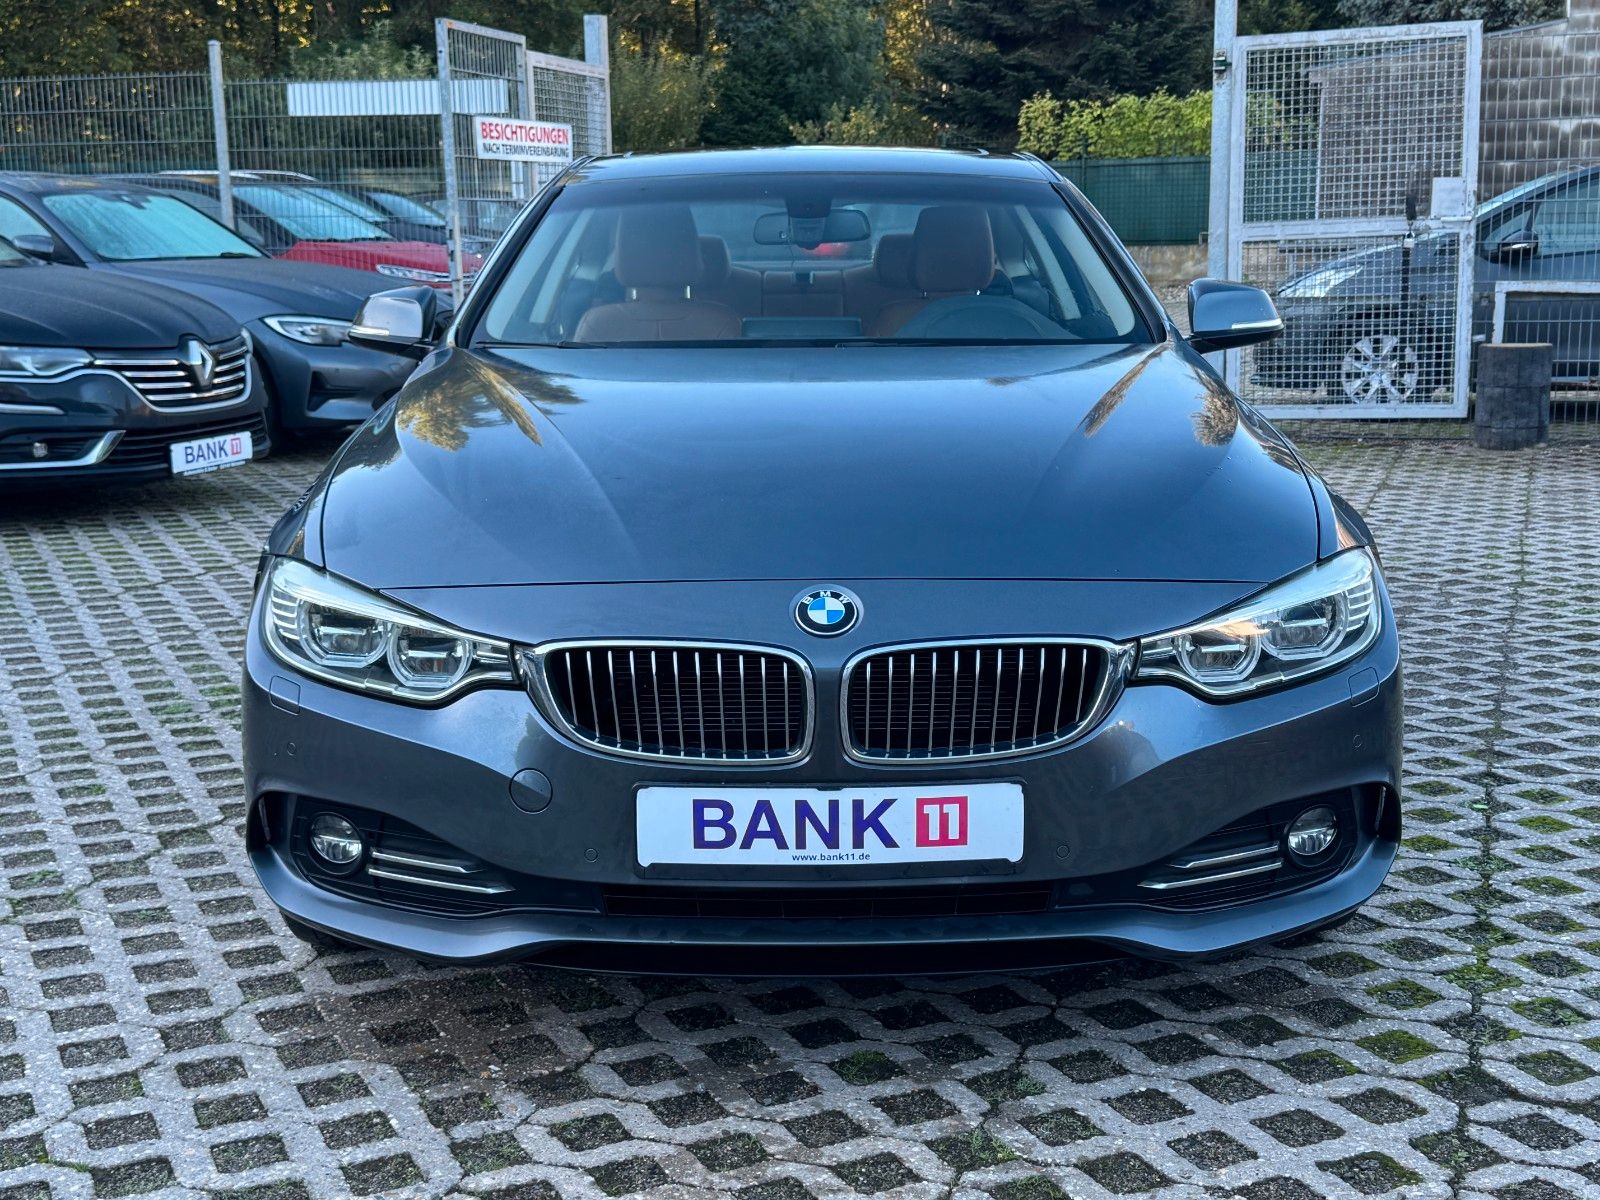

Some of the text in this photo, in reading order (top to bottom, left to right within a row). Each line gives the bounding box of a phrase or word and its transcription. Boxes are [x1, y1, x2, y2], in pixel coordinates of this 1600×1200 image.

[480, 121, 569, 145] BESICHTIGUNGEN
[483, 143, 569, 158] NACH TERMINVEREINBARUNG
[184, 439, 229, 465] BANK
[802, 591, 851, 604] BMW
[691, 797, 962, 850] BANK 11
[791, 852, 871, 863] www.bank11.de
